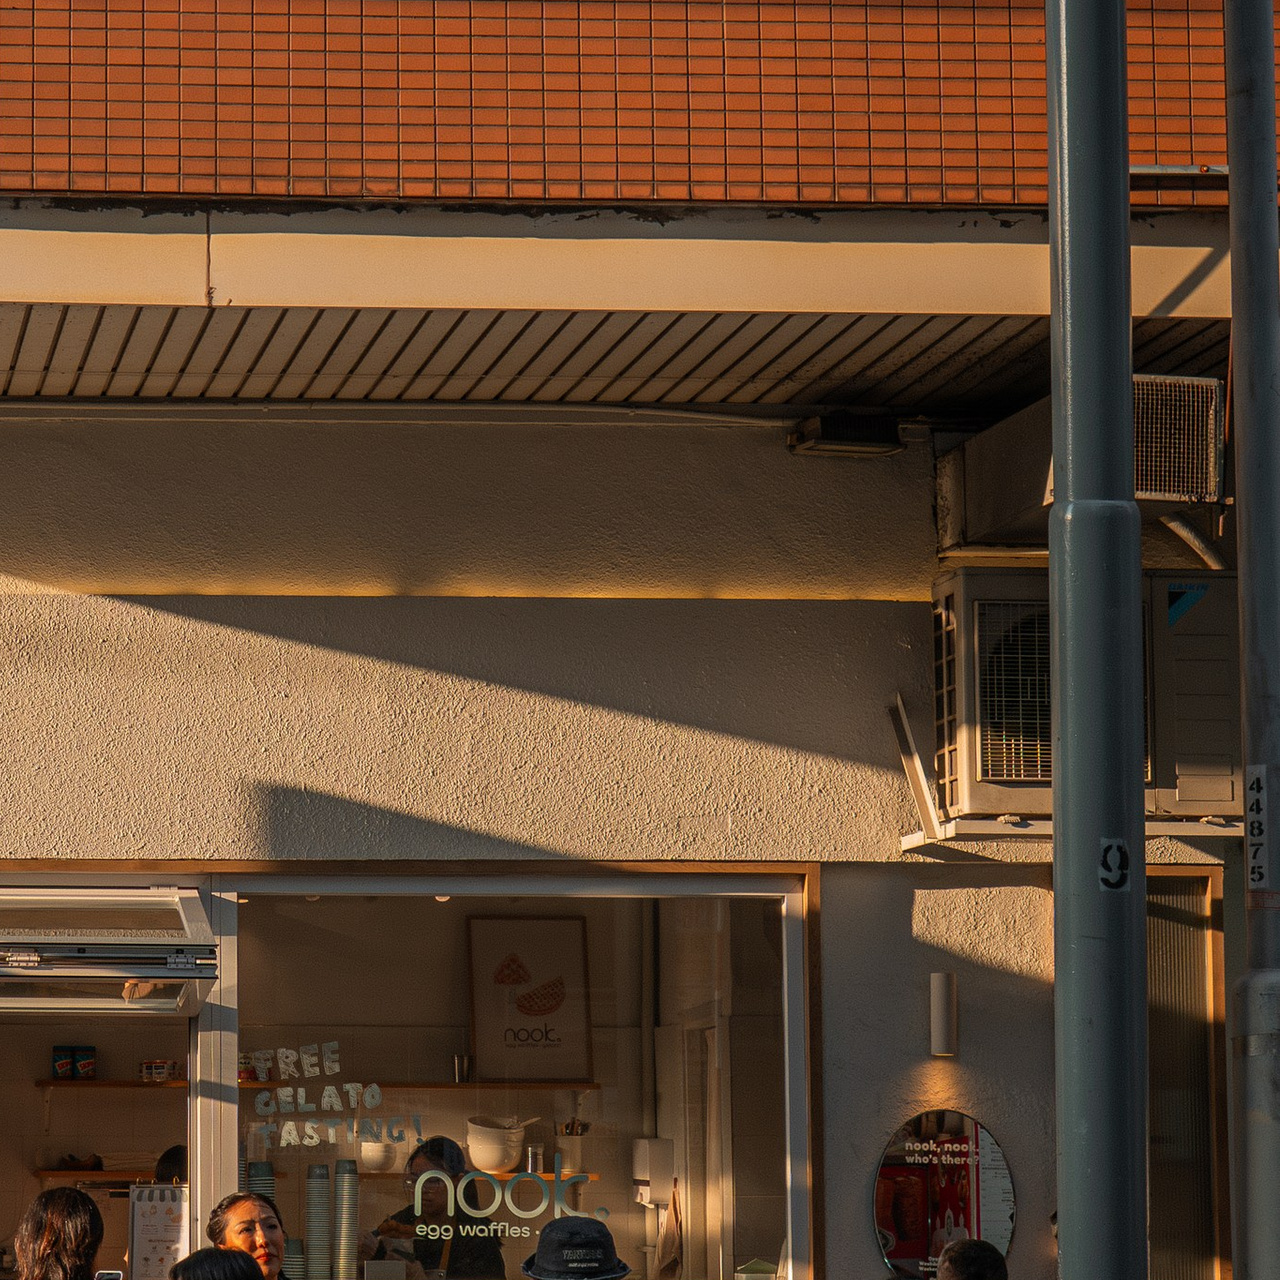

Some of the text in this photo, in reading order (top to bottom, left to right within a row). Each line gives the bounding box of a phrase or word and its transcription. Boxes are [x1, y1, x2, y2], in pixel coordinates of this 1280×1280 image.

[253, 1041, 341, 1081] FREE
[254, 1083, 382, 1116] GELATO
[258, 1113, 424, 1149] TASTING!
[905, 1140, 941, 1153] nook,
[905, 1154, 980, 1165] who's there?
[415, 1222, 531, 1240] egg waffles
